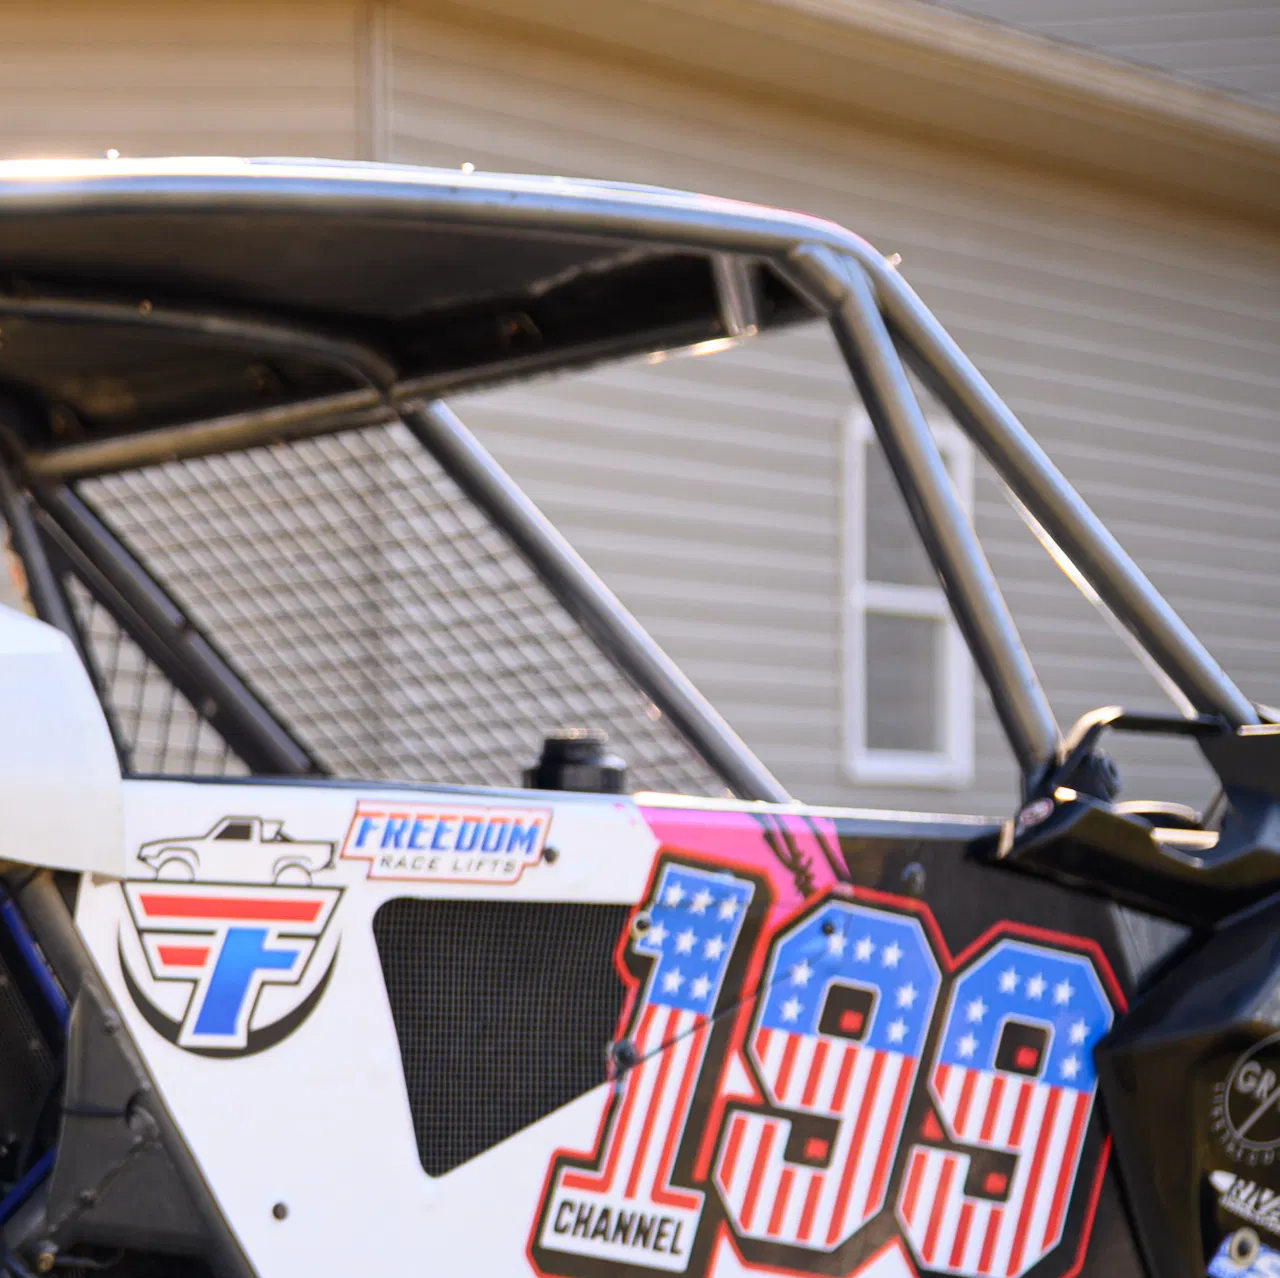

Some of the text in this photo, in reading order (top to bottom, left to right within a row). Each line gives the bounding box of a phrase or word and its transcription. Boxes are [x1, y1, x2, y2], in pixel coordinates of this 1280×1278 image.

[356, 811, 541, 856] FREEDOM
[380, 853, 517, 875] RACE LIFTS
[553, 1197, 686, 1257] CHANNEL
